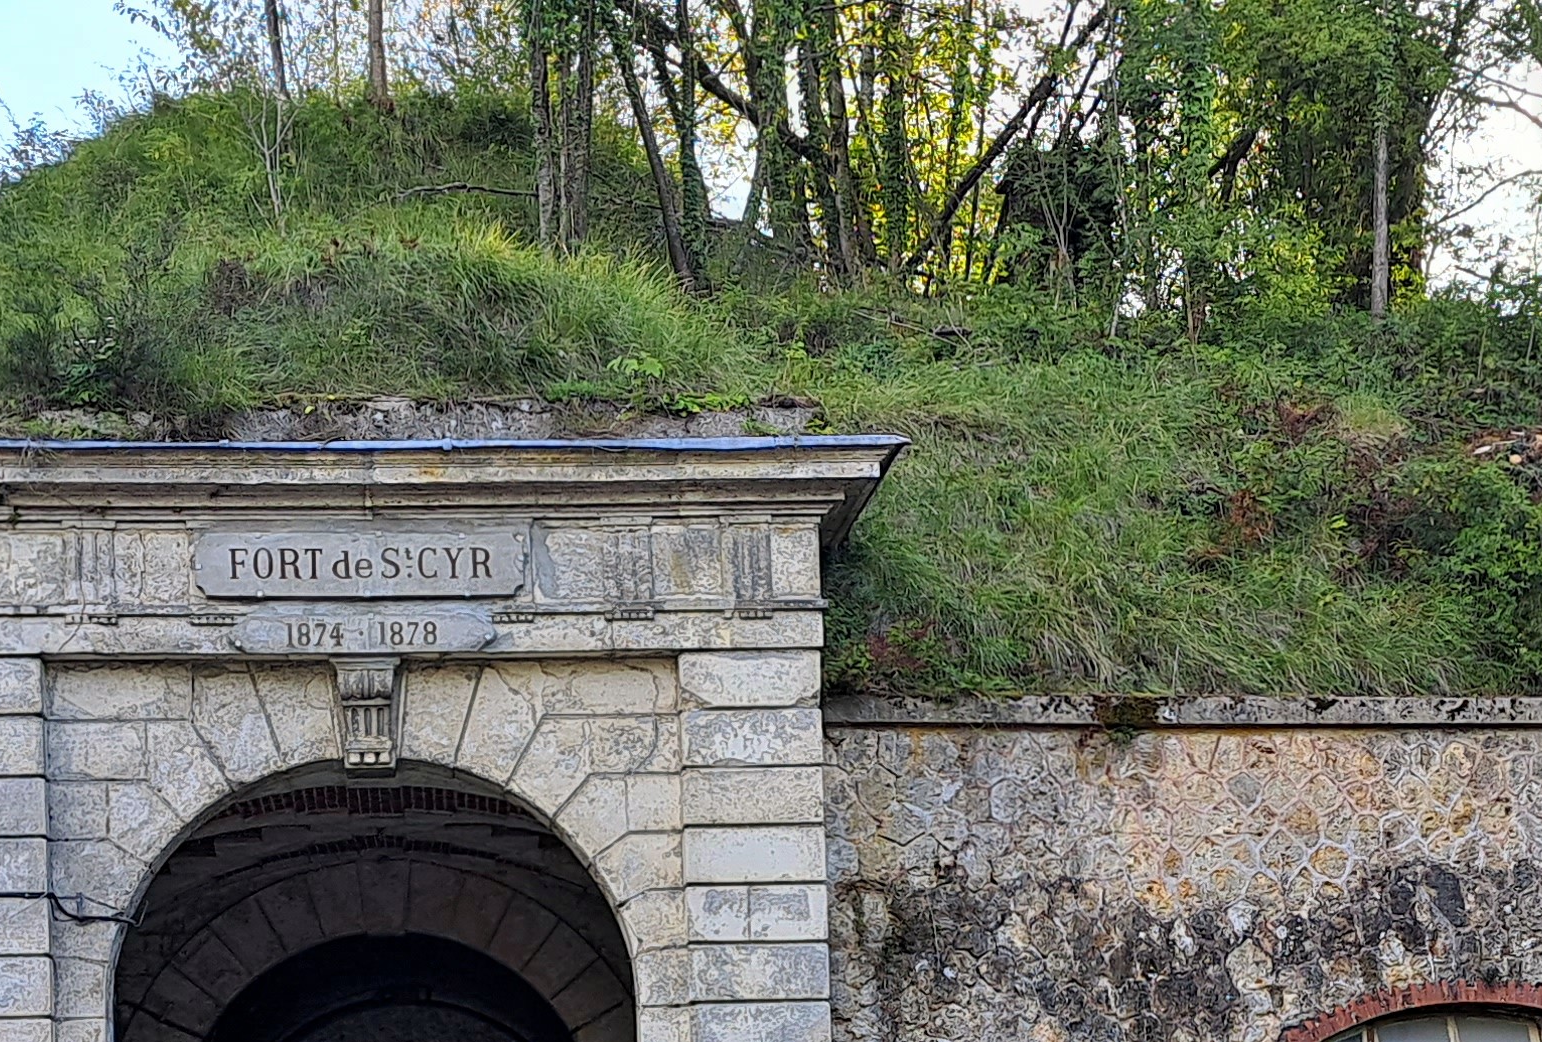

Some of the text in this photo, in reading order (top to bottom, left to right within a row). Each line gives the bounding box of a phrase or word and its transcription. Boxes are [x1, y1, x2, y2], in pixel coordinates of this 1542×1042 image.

[228, 547, 323, 580] FORT
[331, 550, 373, 579] de
[285, 622, 344, 648] 1874
[378, 621, 438, 646] 1878
